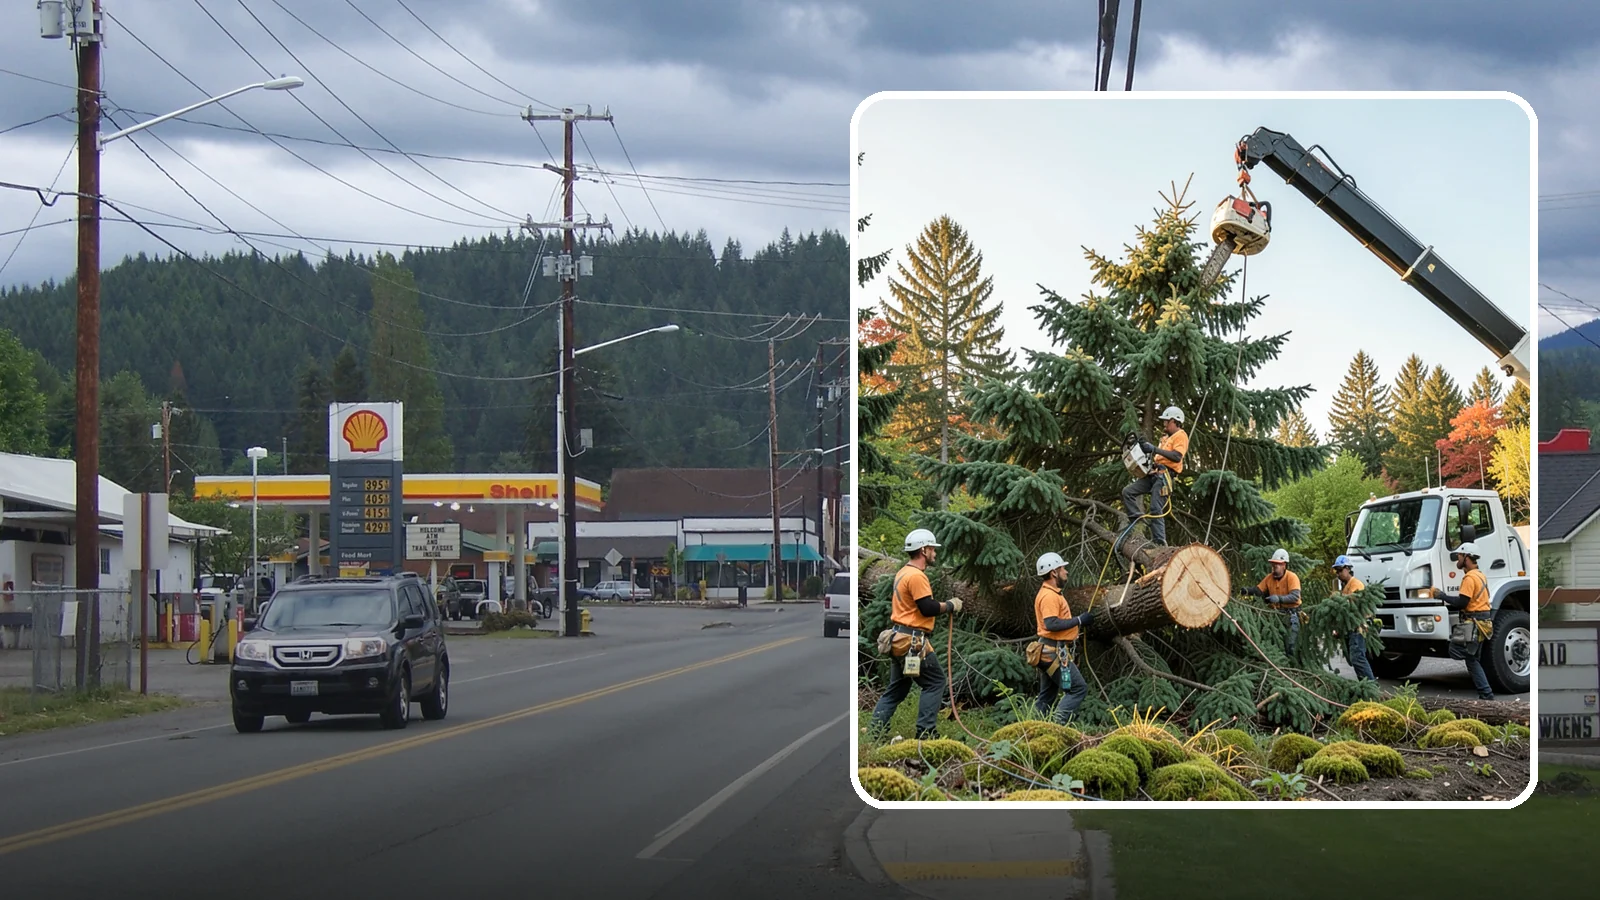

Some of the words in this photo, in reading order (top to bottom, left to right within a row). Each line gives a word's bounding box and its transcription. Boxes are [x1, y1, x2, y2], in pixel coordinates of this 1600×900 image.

[366, 480, 383, 490] 395
[490, 484, 547, 498] Shell
[366, 494, 383, 504] 405
[366, 508, 383, 518] 415
[366, 522, 383, 532] 429
